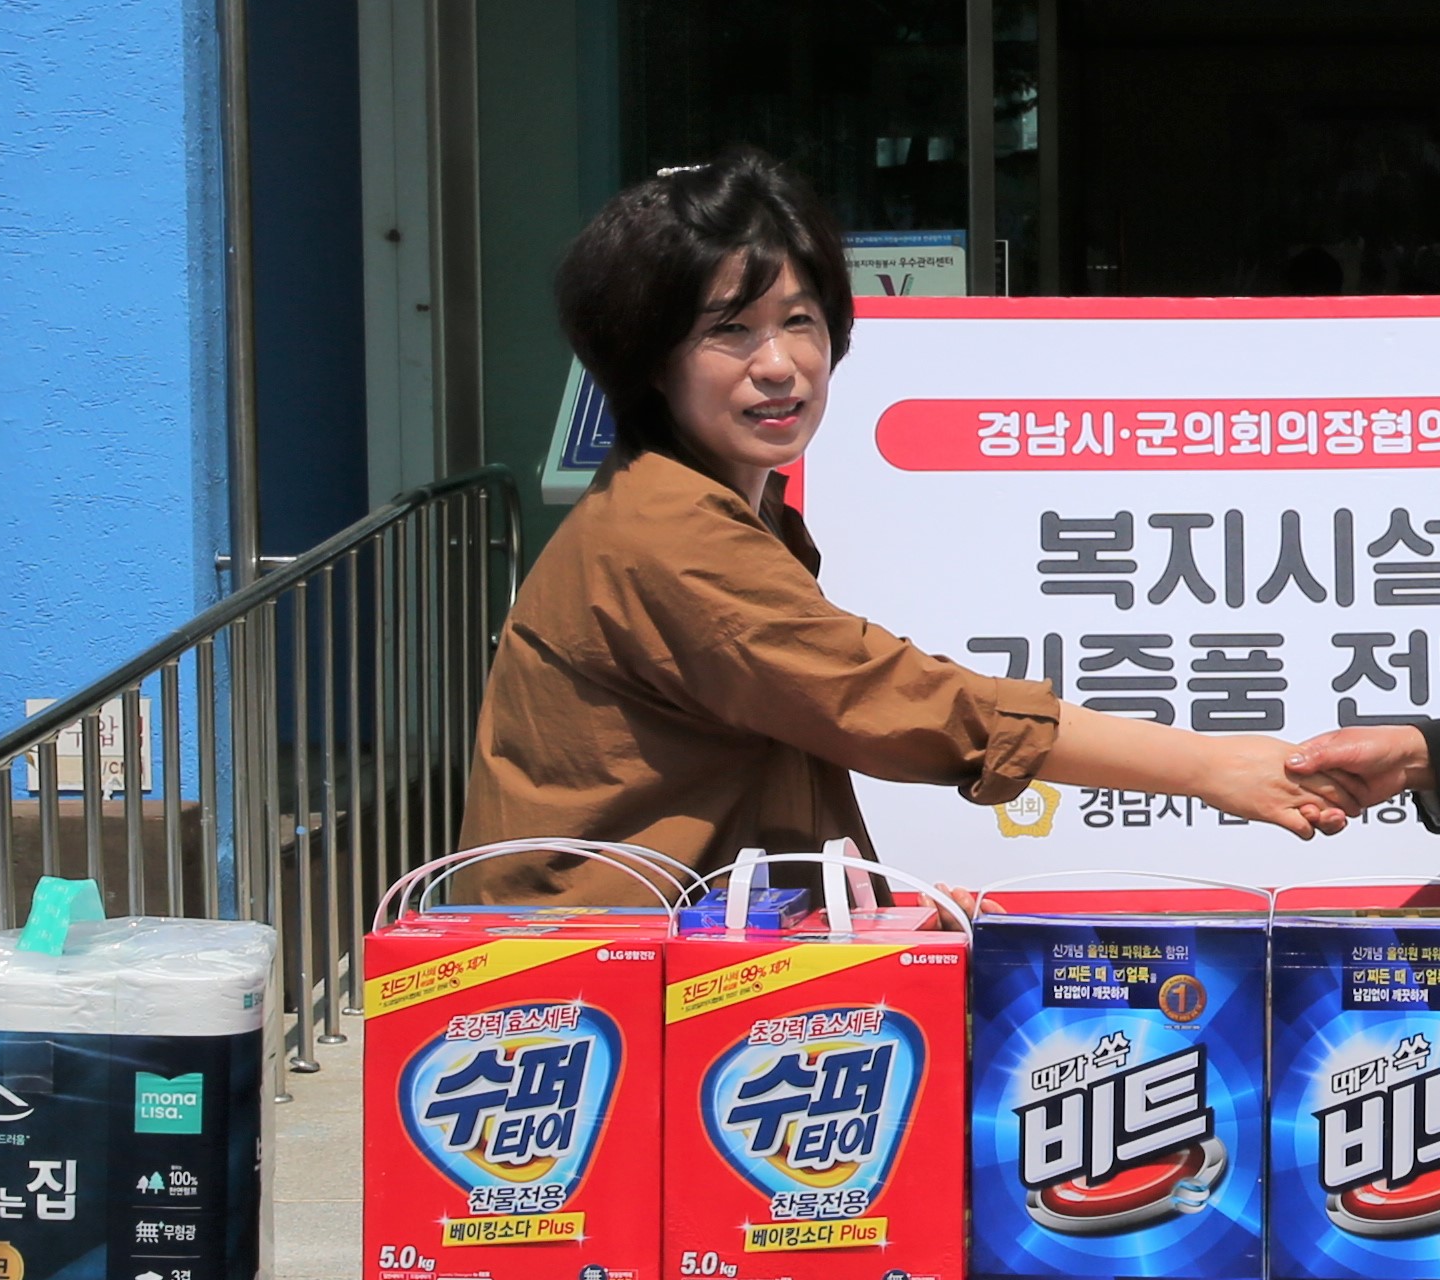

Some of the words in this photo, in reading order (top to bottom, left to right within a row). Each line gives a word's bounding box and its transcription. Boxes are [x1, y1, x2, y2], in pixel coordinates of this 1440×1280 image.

[899, 257, 953, 268] 우수관리센터
[966, 633, 1286, 731] 기증품
[1008, 798, 1042, 815] 의회
[611, 950, 655, 960] LG생활건강
[913, 954, 958, 965] LG생활건강
[1052, 944, 1083, 958] 신개념
[1122, 945, 1162, 959] 파워효소
[1165, 945, 1189, 960] 함유!
[1352, 947, 1383, 961] 신개념
[380, 972, 421, 999] 진드기
[437, 961, 464, 981] 99%
[466, 953, 488, 970] 제거
[683, 976, 723, 1004] 진드기
[740, 966, 766, 984] 99%
[769, 958, 791, 975] 제거
[1068, 966, 1091, 982] 찌든
[1095, 966, 1107, 982] 때
[1053, 986, 1090, 999] 남김없이
[1092, 986, 1129, 1000] 깨끗하게
[1172, 984, 1186, 1012] 1
[1353, 989, 1389, 1002] 남김없이
[1392, 989, 1428, 1002] 깨끗하게
[448, 1011, 504, 1039] 초강력
[507, 1006, 579, 1032] 효소세탁
[749, 1017, 805, 1044] 초강력
[809, 1011, 882, 1037] 효소세탁
[1032, 1055, 1088, 1091] 때가
[1092, 1031, 1131, 1068] 쏙
[1332, 1056, 1388, 1093] 때가
[1392, 1033, 1430, 1071] 쏙
[141, 1092, 197, 1106] mona
[425, 1041, 588, 1145] 수퍼
[727, 1043, 894, 1150] 수퍼
[1024, 1051, 1207, 1183] 비트
[493, 1115, 571, 1158] 타이
[794, 1117, 874, 1163] 타이
[169, 1171, 198, 1186] 100%
[470, 1185, 564, 1212] 찬물전용
[772, 1190, 868, 1217] 찬물전용
[135, 1220, 159, 1243] 無
[164, 1225, 196, 1241] 무형광
[450, 1219, 531, 1241] 베이킹소다
[538, 1219, 575, 1235] Plus
[751, 1225, 833, 1246] 베이킹소다
[840, 1224, 877, 1240] Plus
